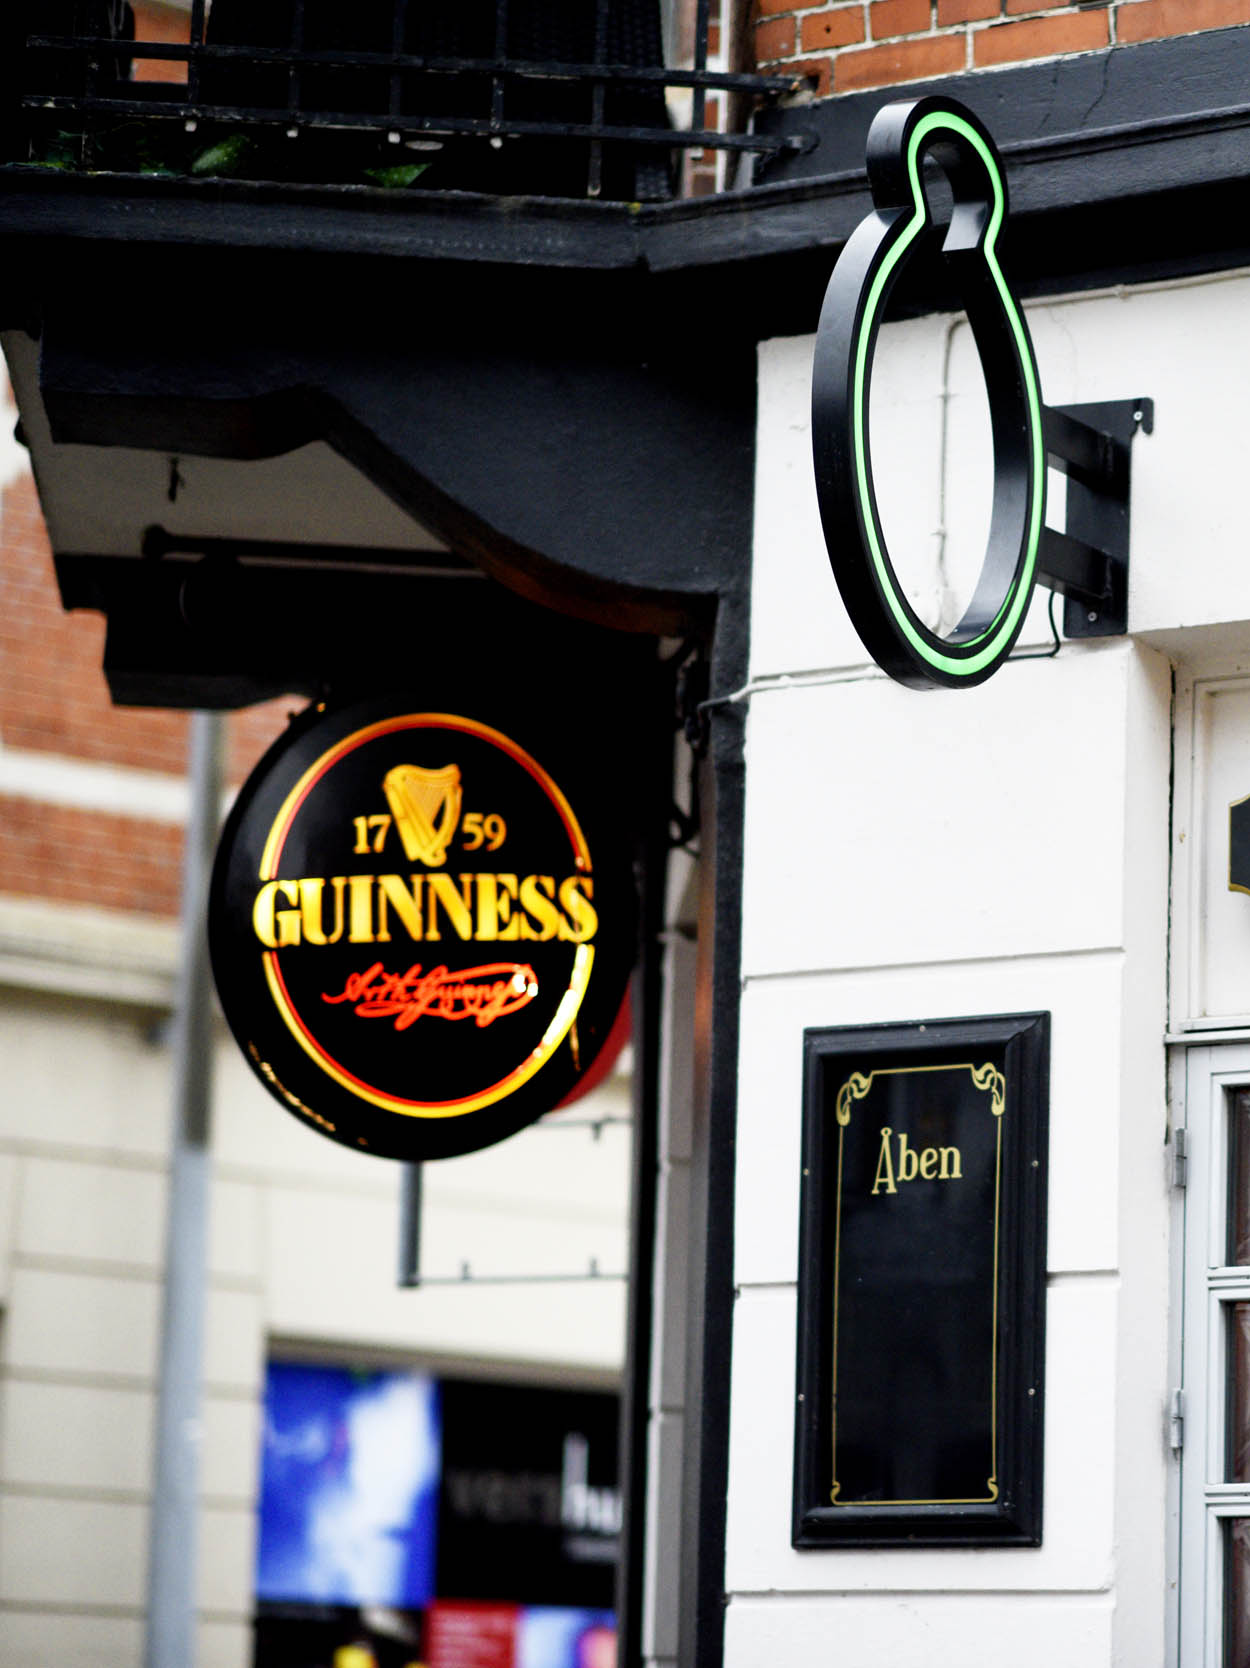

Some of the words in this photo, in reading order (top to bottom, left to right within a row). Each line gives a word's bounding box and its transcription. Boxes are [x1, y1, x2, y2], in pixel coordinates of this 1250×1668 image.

[352, 814, 391, 854] 17
[461, 813, 507, 851] 59
[252, 872, 599, 948] GUINNESS
[870, 1126, 963, 1195] Åben
